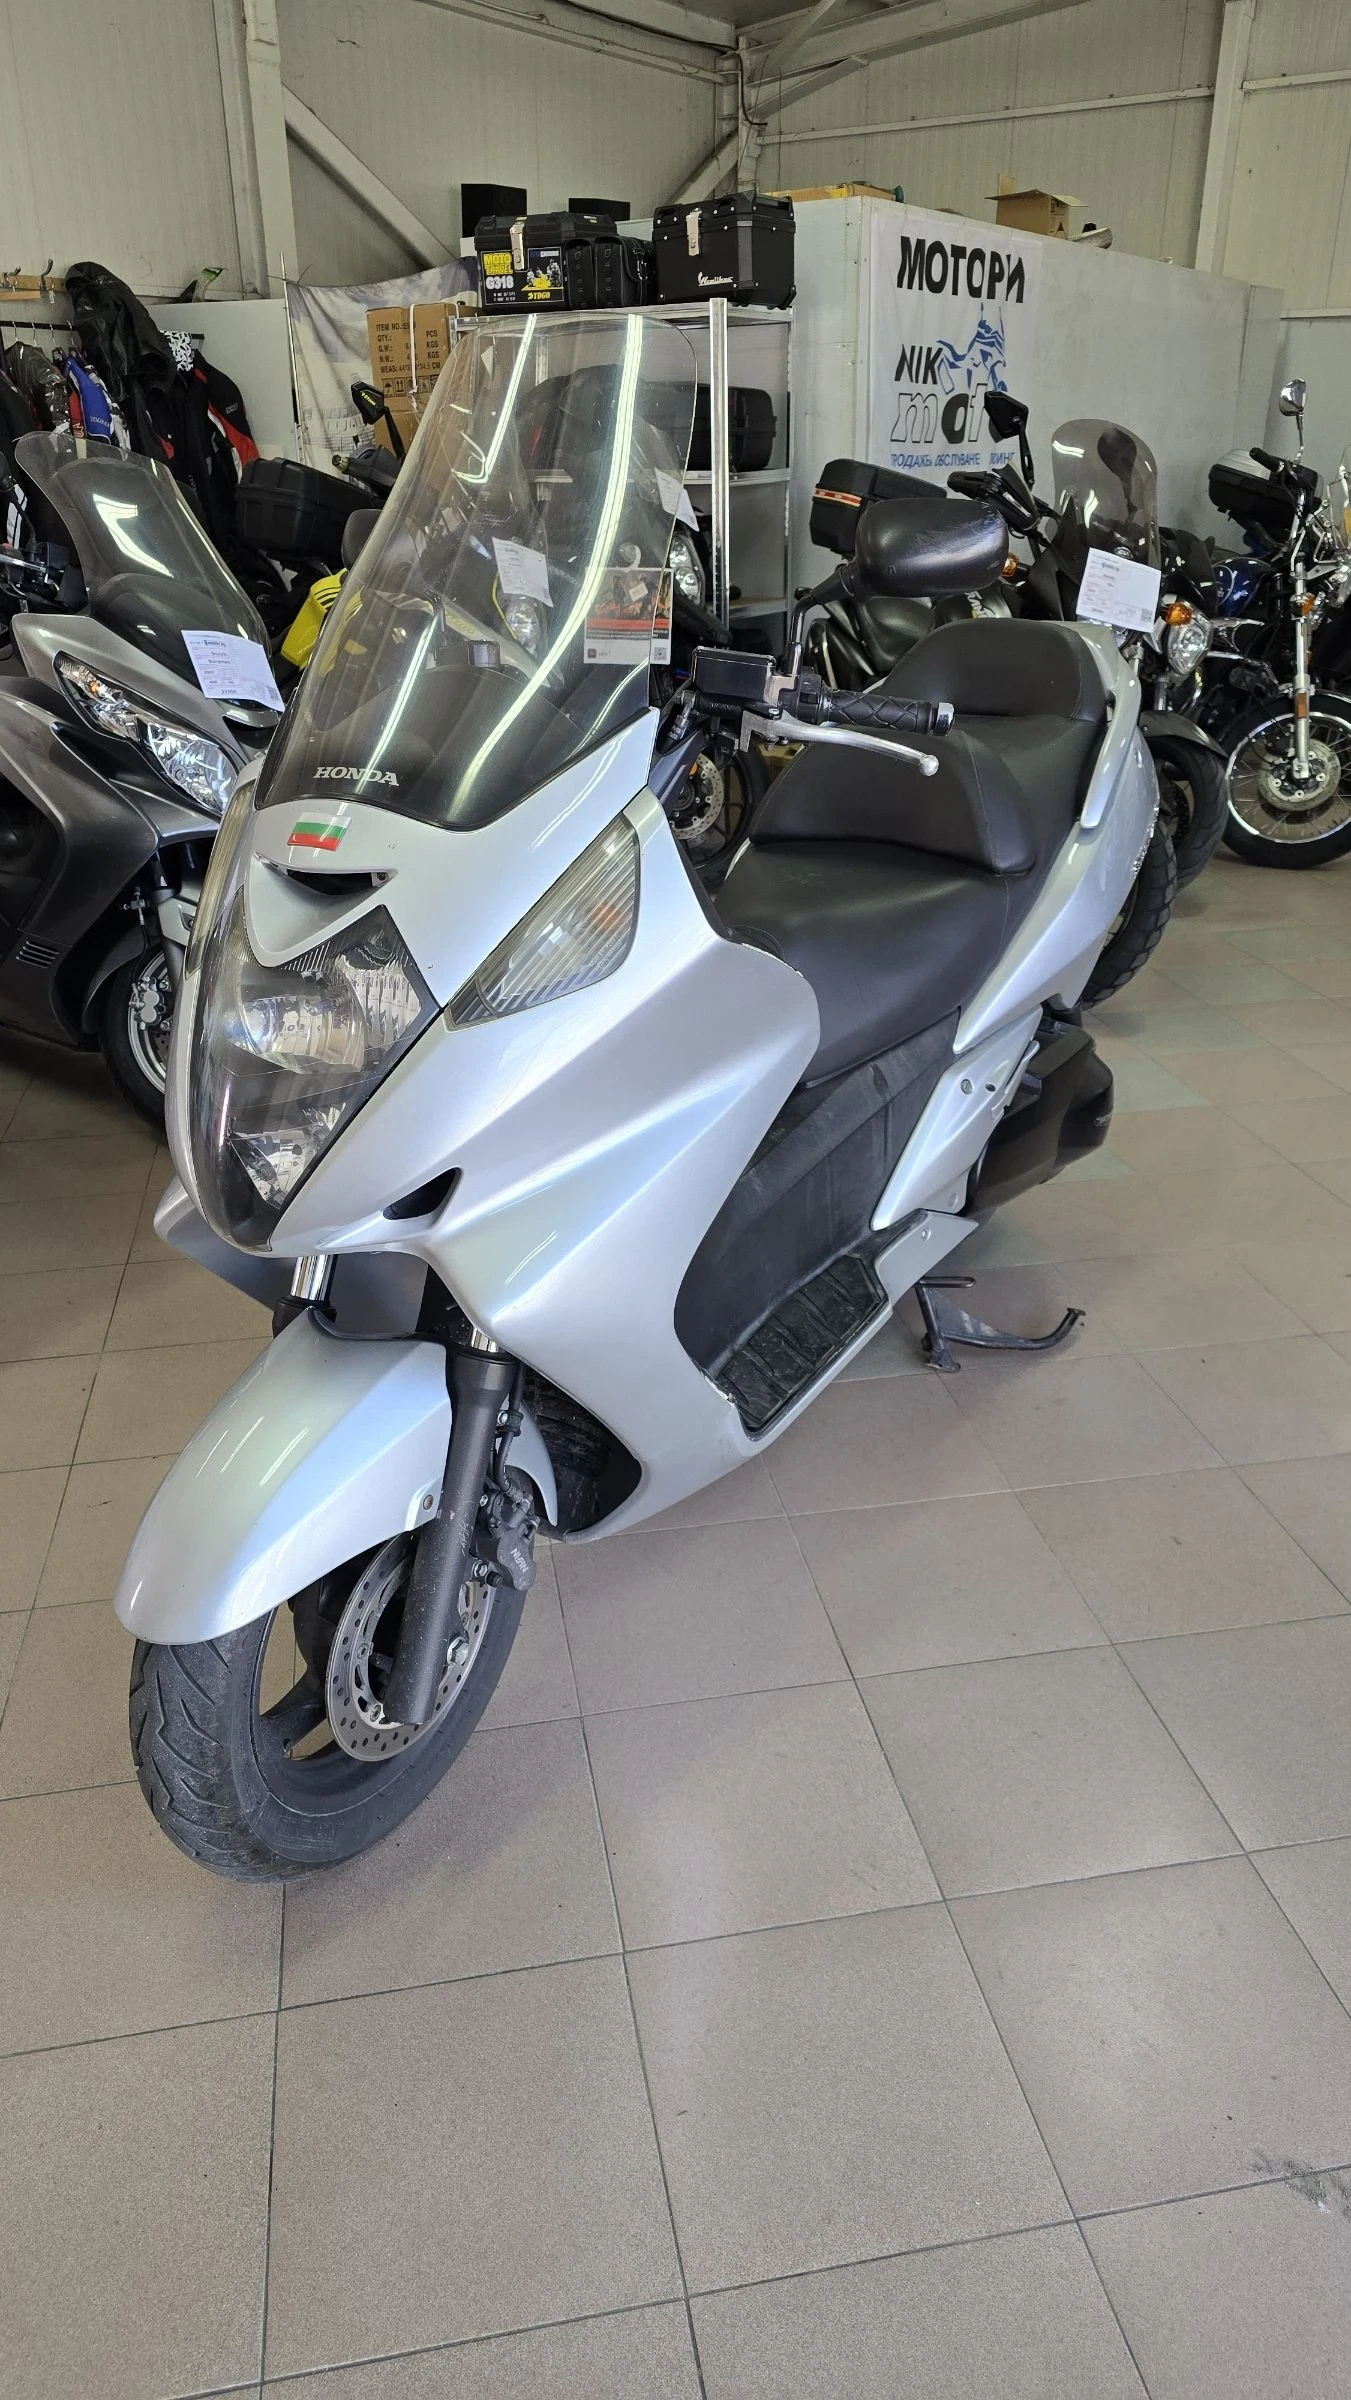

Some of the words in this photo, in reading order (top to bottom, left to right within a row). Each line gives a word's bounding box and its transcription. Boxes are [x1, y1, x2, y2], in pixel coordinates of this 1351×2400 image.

[483, 252, 512, 265] MOTO
[897, 235, 1025, 304] МОТОРИ
[485, 275, 514, 289] G318
[376, 322, 390, 332] ITEM
[426, 329, 438, 338] PCS
[426, 340, 439, 349] KGS
[427, 350, 440, 359] KGS
[890, 382, 1003, 444] mot
[312, 766, 400, 787] HONDA
